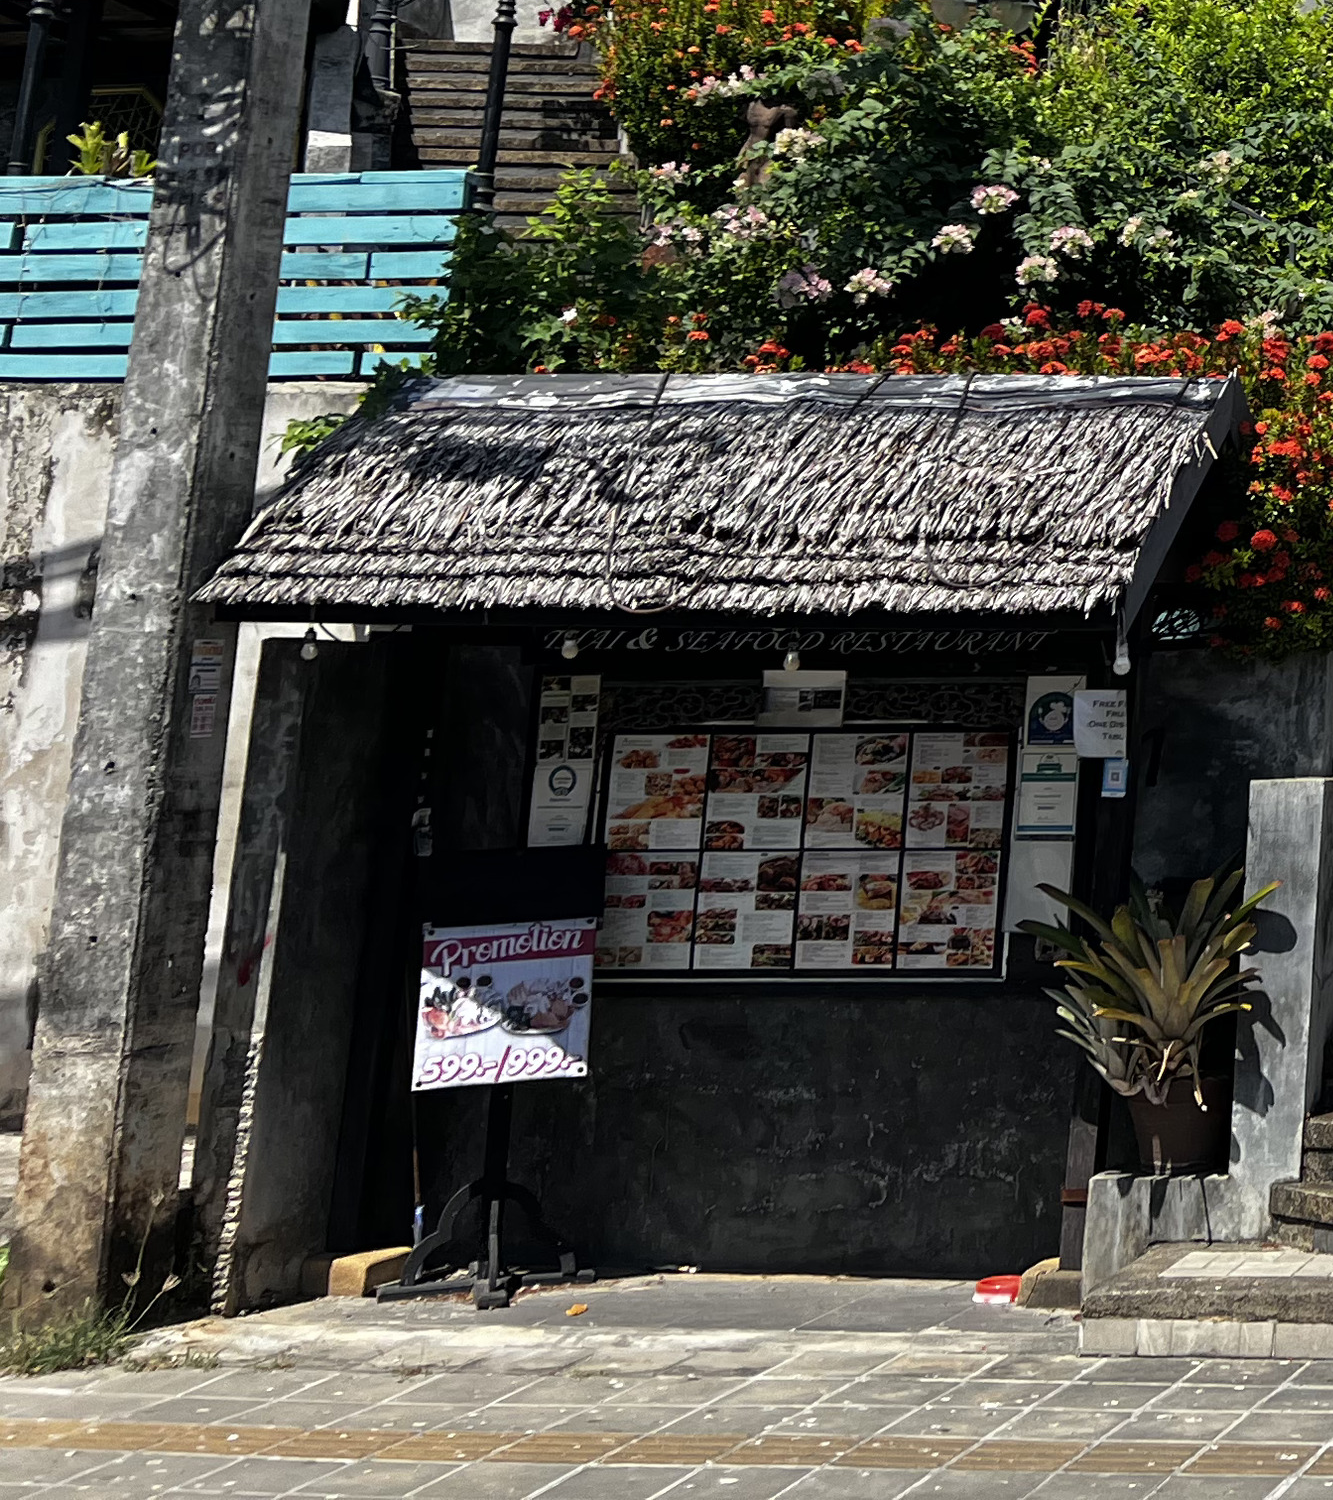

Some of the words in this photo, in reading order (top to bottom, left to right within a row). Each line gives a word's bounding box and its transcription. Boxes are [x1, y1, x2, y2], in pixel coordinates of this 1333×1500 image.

[626, 627, 658, 651] &
[828, 628, 1059, 654] RESTAURANT
[429, 922, 586, 977] Promotion
